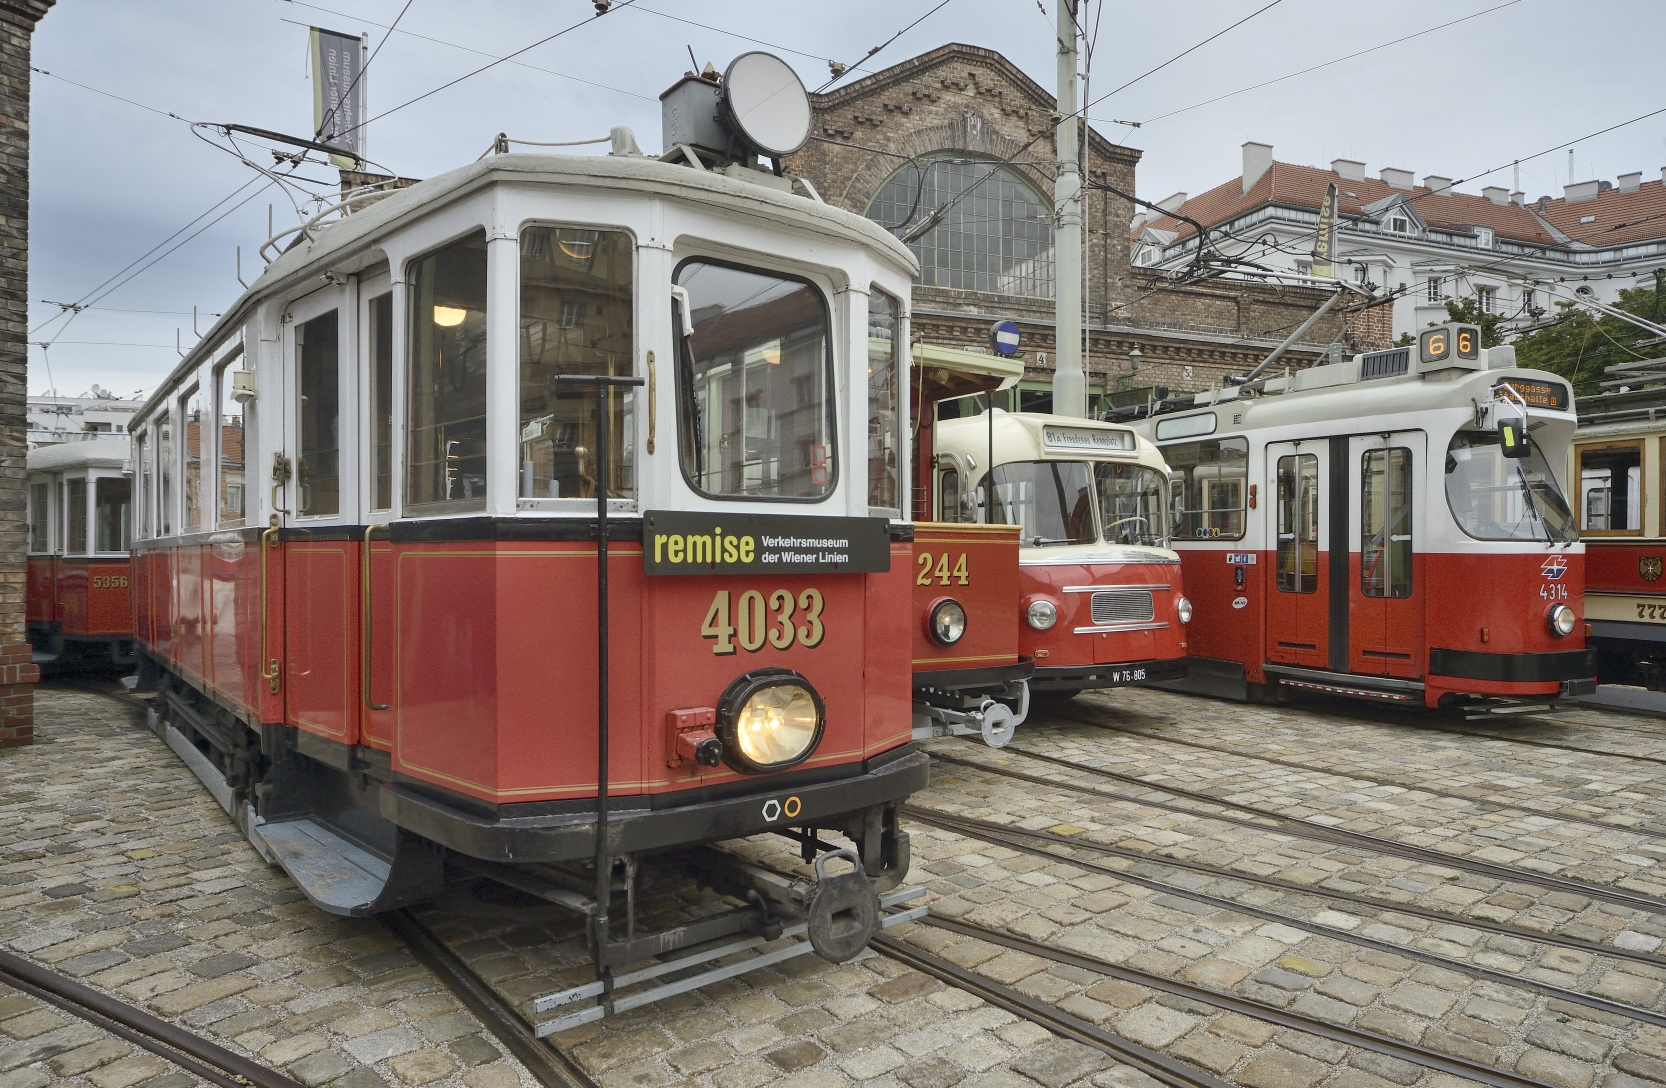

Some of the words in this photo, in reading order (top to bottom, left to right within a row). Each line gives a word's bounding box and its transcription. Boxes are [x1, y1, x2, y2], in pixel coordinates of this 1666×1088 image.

[1429, 334, 1444, 355] 6
[1459, 333, 1471, 353] 6
[654, 527, 755, 564] remise
[761, 535, 849, 548] Verkehrsmuseum
[761, 552, 779, 563] der
[781, 552, 817, 563] Wiener
[819, 552, 849, 563] Linien
[916, 552, 969, 586] 244
[93, 575, 129, 588] 5356
[1539, 583, 1568, 600] 4314
[701, 587, 826, 656] 4033
[1112, 671, 1120, 682] W
